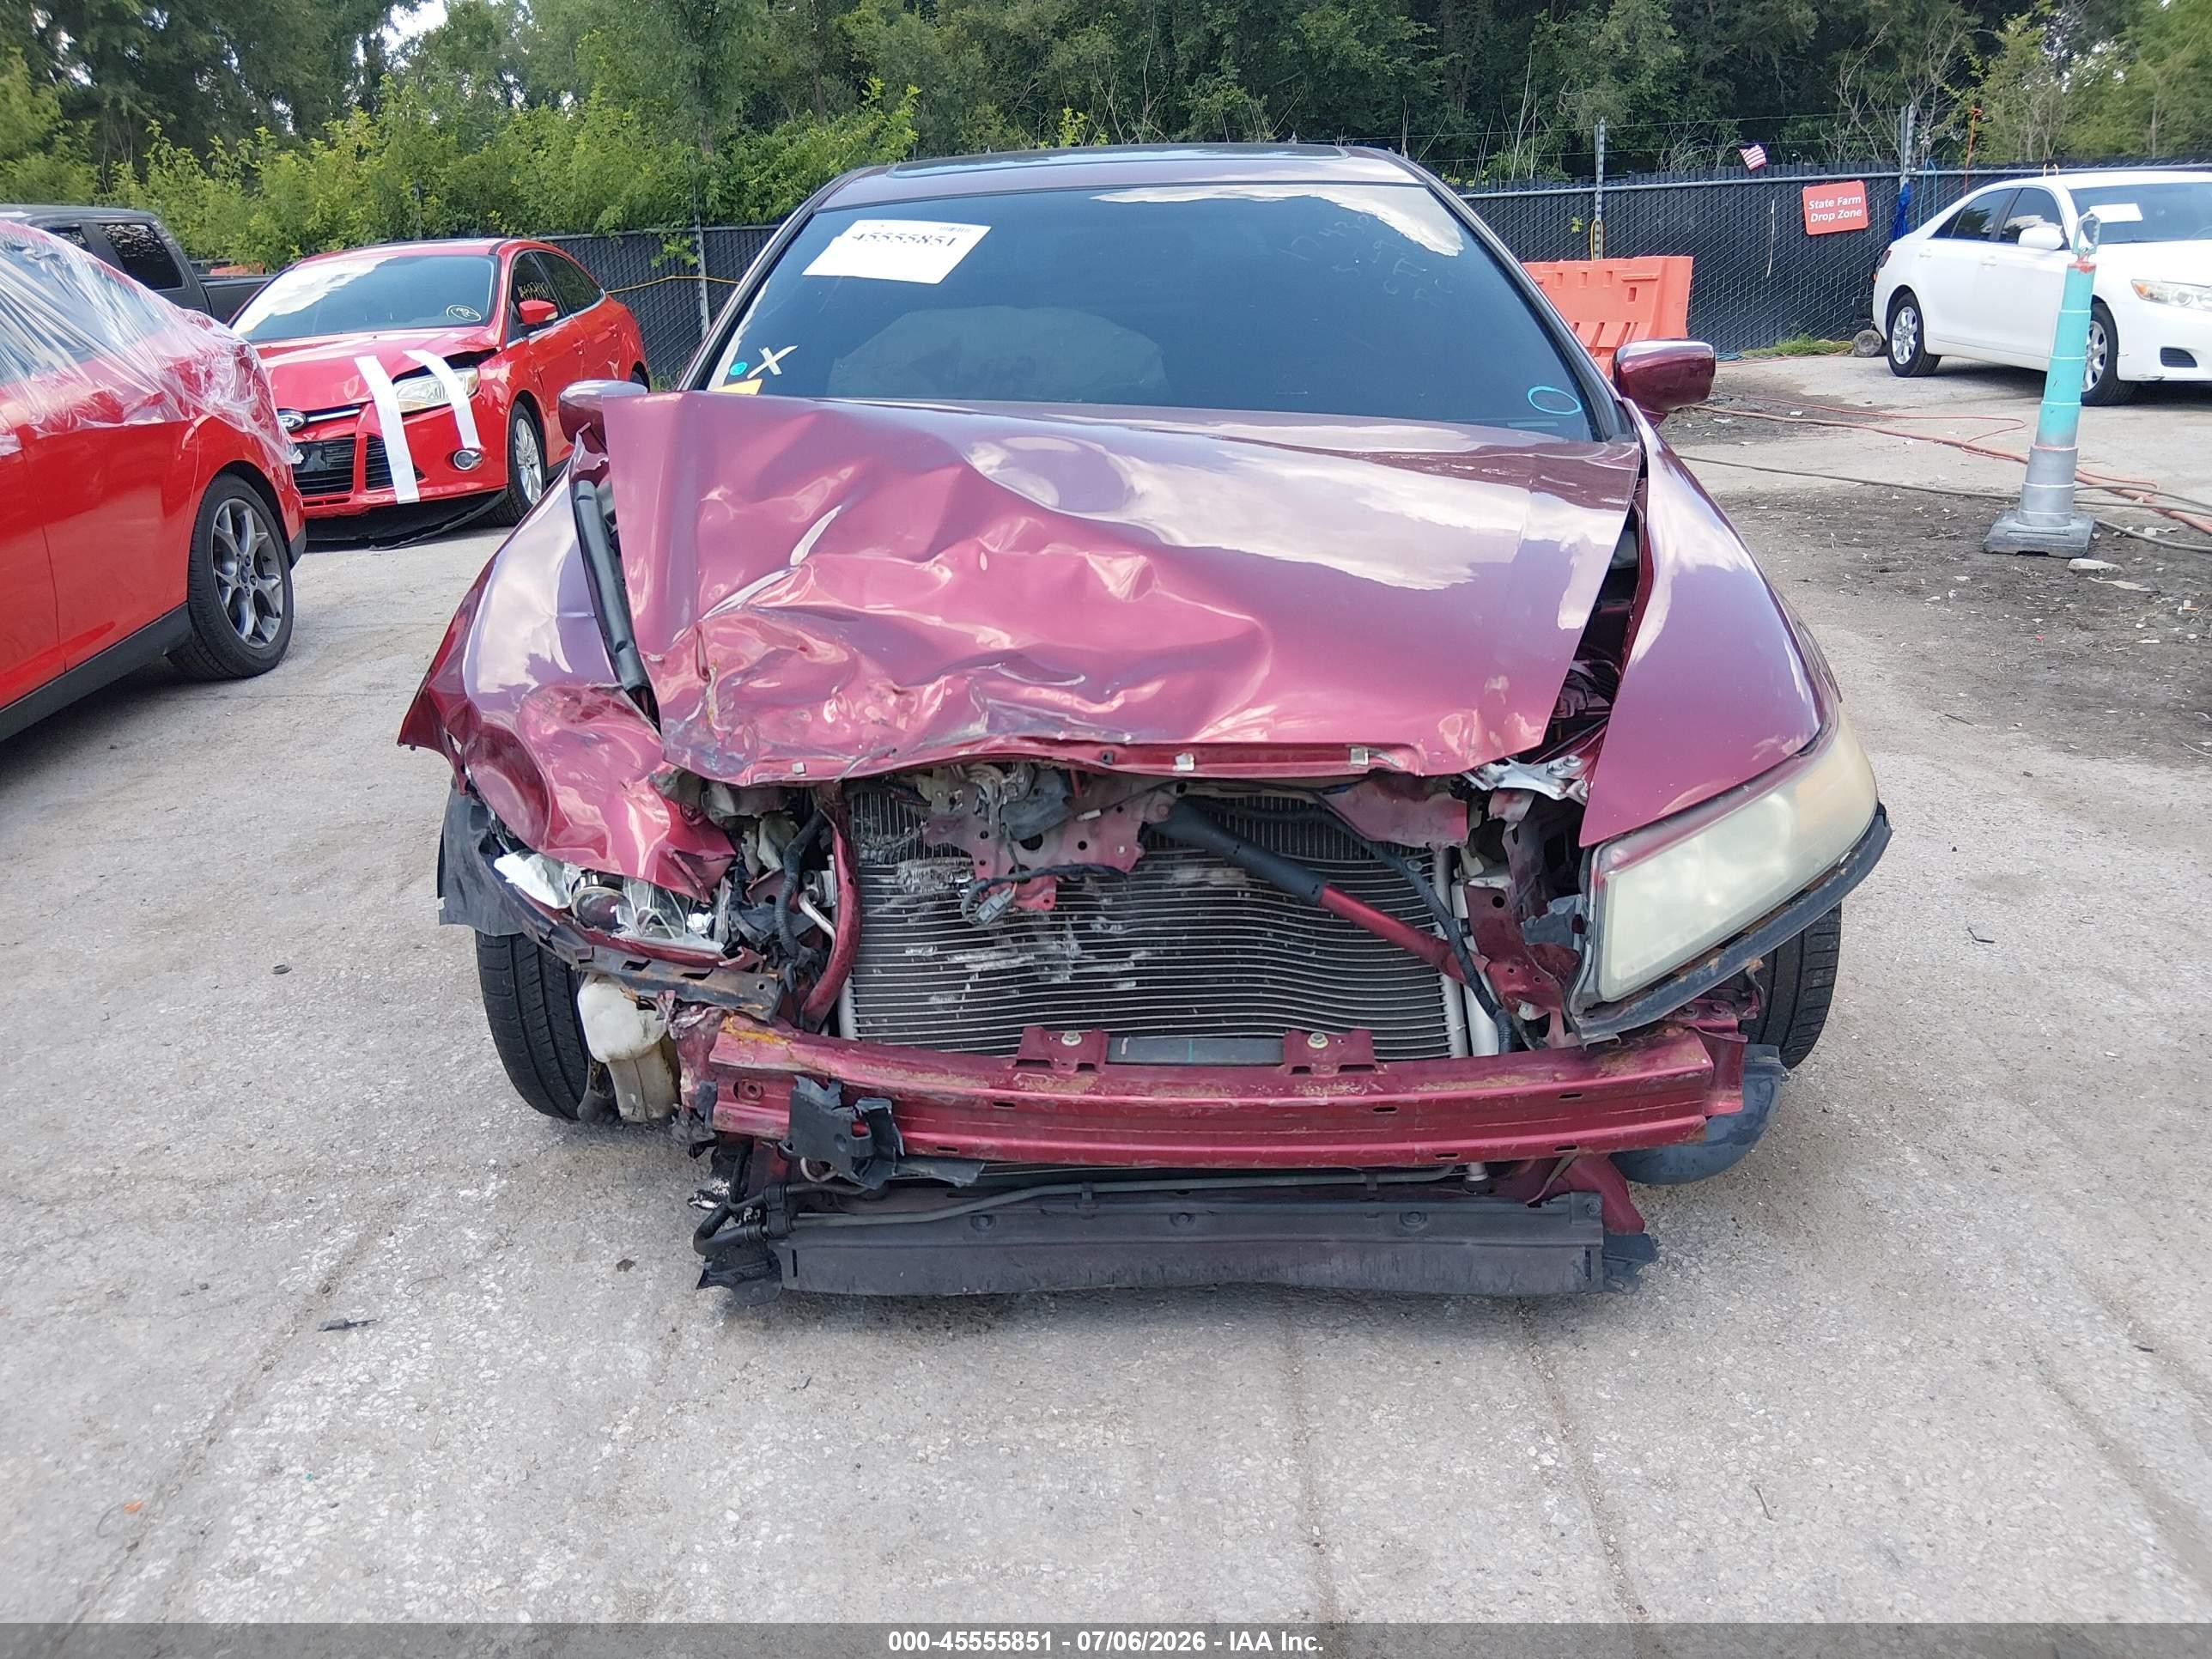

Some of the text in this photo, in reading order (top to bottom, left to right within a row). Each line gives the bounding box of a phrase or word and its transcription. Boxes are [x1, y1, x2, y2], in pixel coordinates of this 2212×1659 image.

[1808, 196, 1862, 210] State Farm
[1810, 209, 1863, 222] Drop Zone
